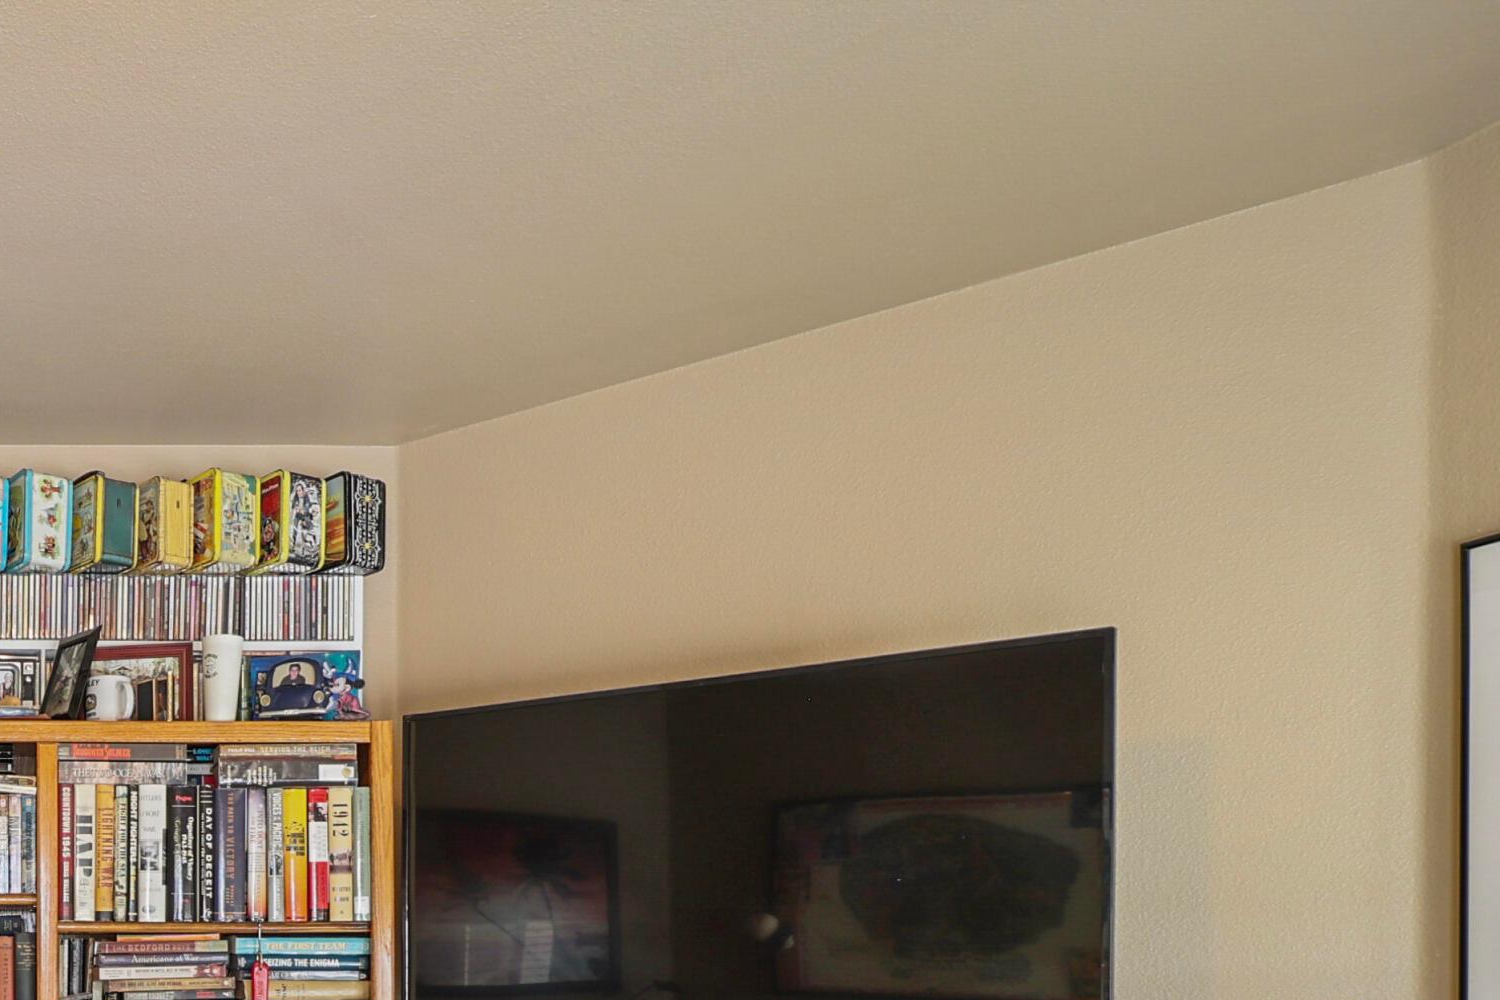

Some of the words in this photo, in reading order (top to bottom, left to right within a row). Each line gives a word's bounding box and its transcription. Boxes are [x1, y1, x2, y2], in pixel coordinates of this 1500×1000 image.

[273, 792, 281, 815] VOICES
[333, 803, 348, 836] 1942
[102, 808, 112, 862] LIGHTNING
[206, 834, 212, 849] OF
[273, 822, 281, 847] PACIFIC
[102, 867, 112, 888] WAR
